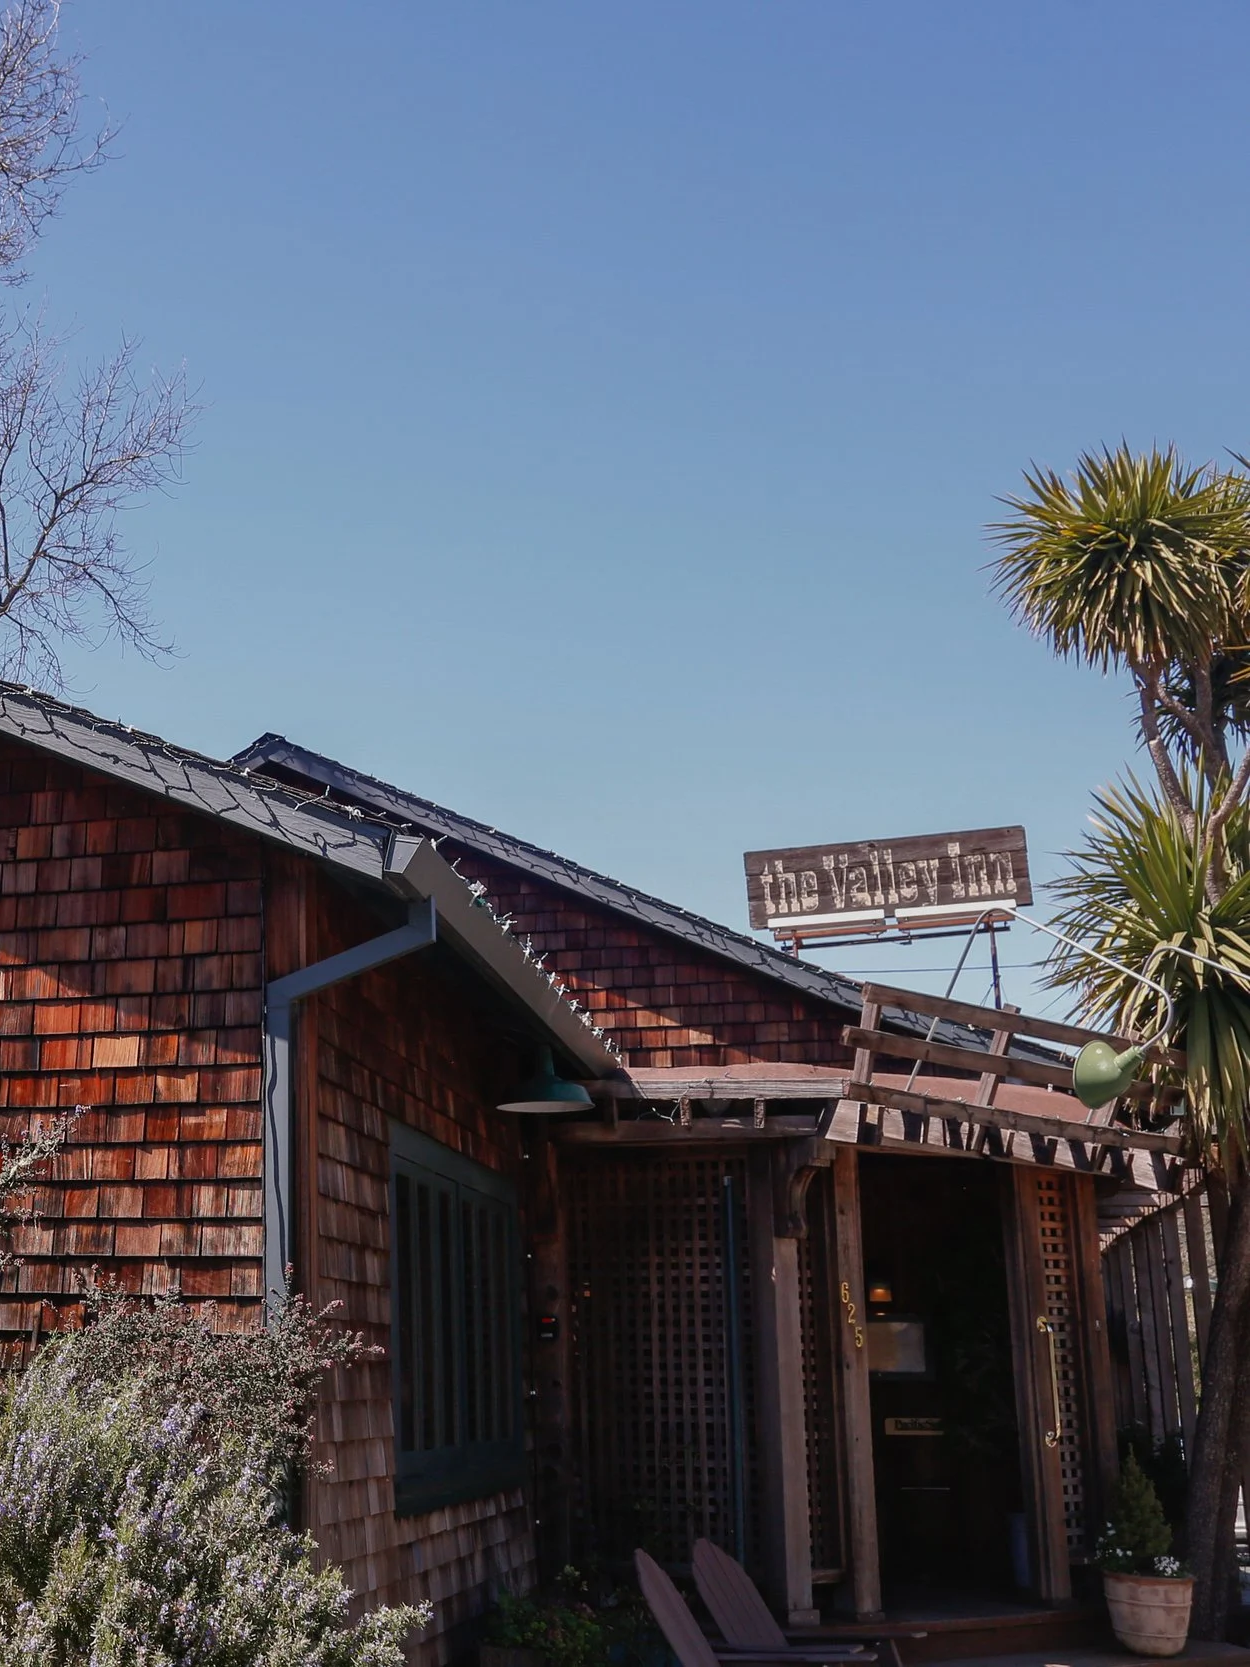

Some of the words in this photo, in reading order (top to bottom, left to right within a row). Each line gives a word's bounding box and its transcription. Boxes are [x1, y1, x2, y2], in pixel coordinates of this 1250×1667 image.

[760, 860, 819, 914] the
[823, 849, 939, 907] Valley
[841, 1282, 863, 1347] 625
